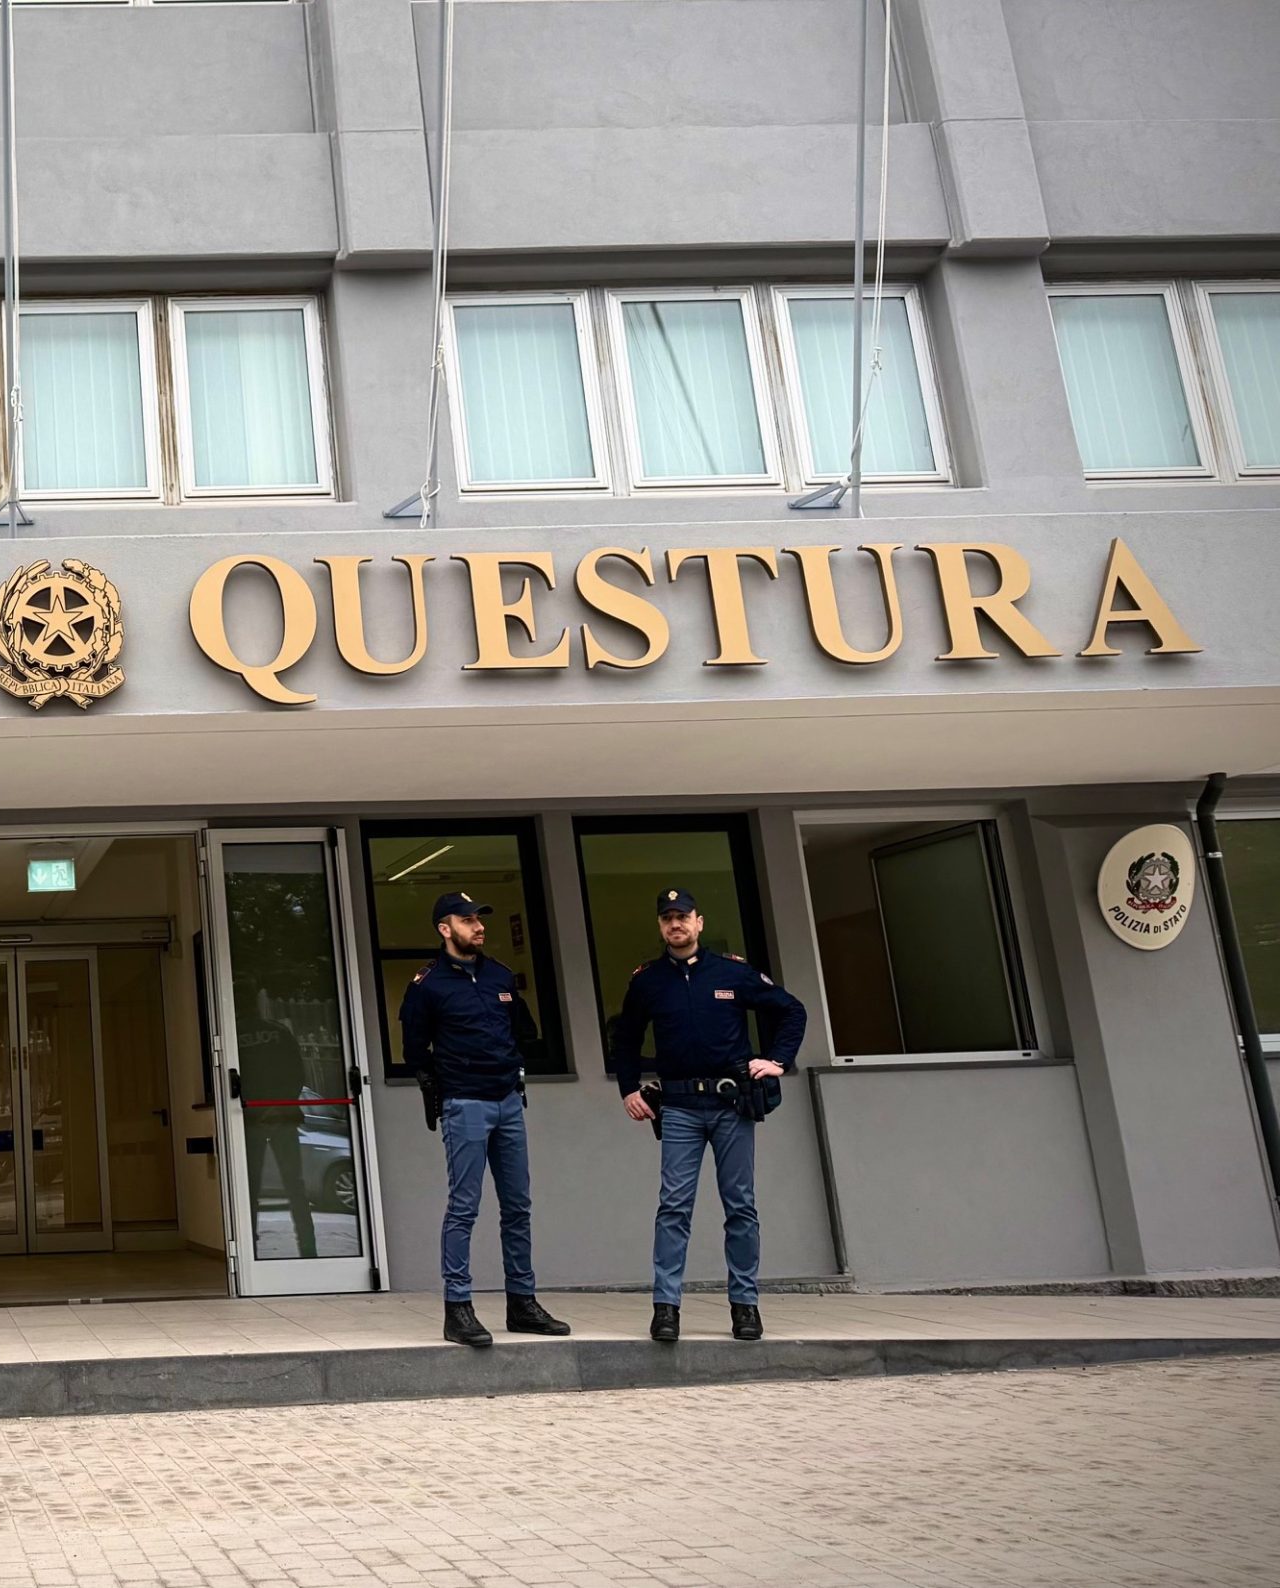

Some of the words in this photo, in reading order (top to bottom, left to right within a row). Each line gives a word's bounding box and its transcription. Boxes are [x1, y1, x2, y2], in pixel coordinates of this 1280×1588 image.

[189, 536, 1204, 705] QUESTURA
[71, 675, 122, 695] ITALIANA
[1108, 905, 1150, 934] POLIZIA
[1153, 925, 1162, 934] DI
[1163, 904, 1187, 931] STATO
